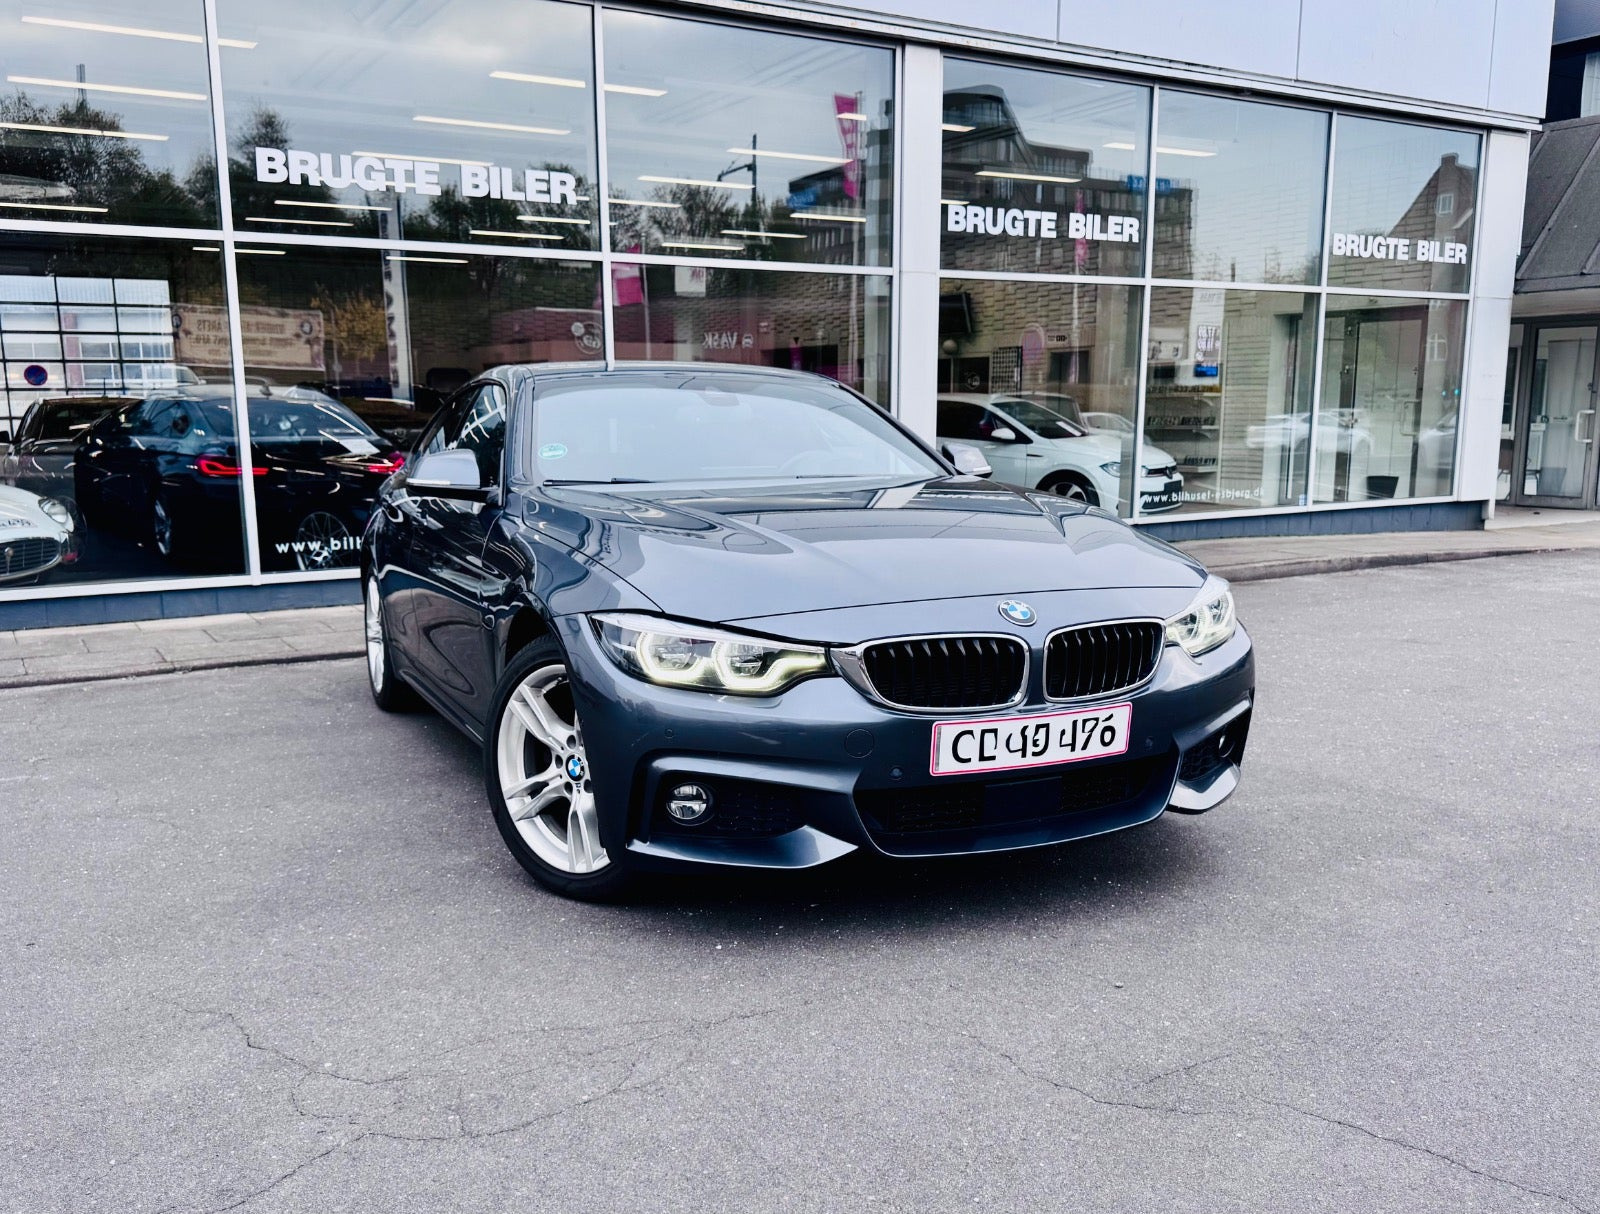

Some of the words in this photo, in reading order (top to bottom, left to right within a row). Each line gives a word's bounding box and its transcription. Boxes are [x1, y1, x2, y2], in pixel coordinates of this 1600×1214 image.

[255, 147, 442, 196] BRUGTE
[460, 164, 578, 205] BILER
[947, 204, 1058, 239] BRUGTE
[1068, 212, 1140, 243] BILER
[1332, 232, 1410, 260] BRUGTE
[1416, 239, 1468, 265] BILER
